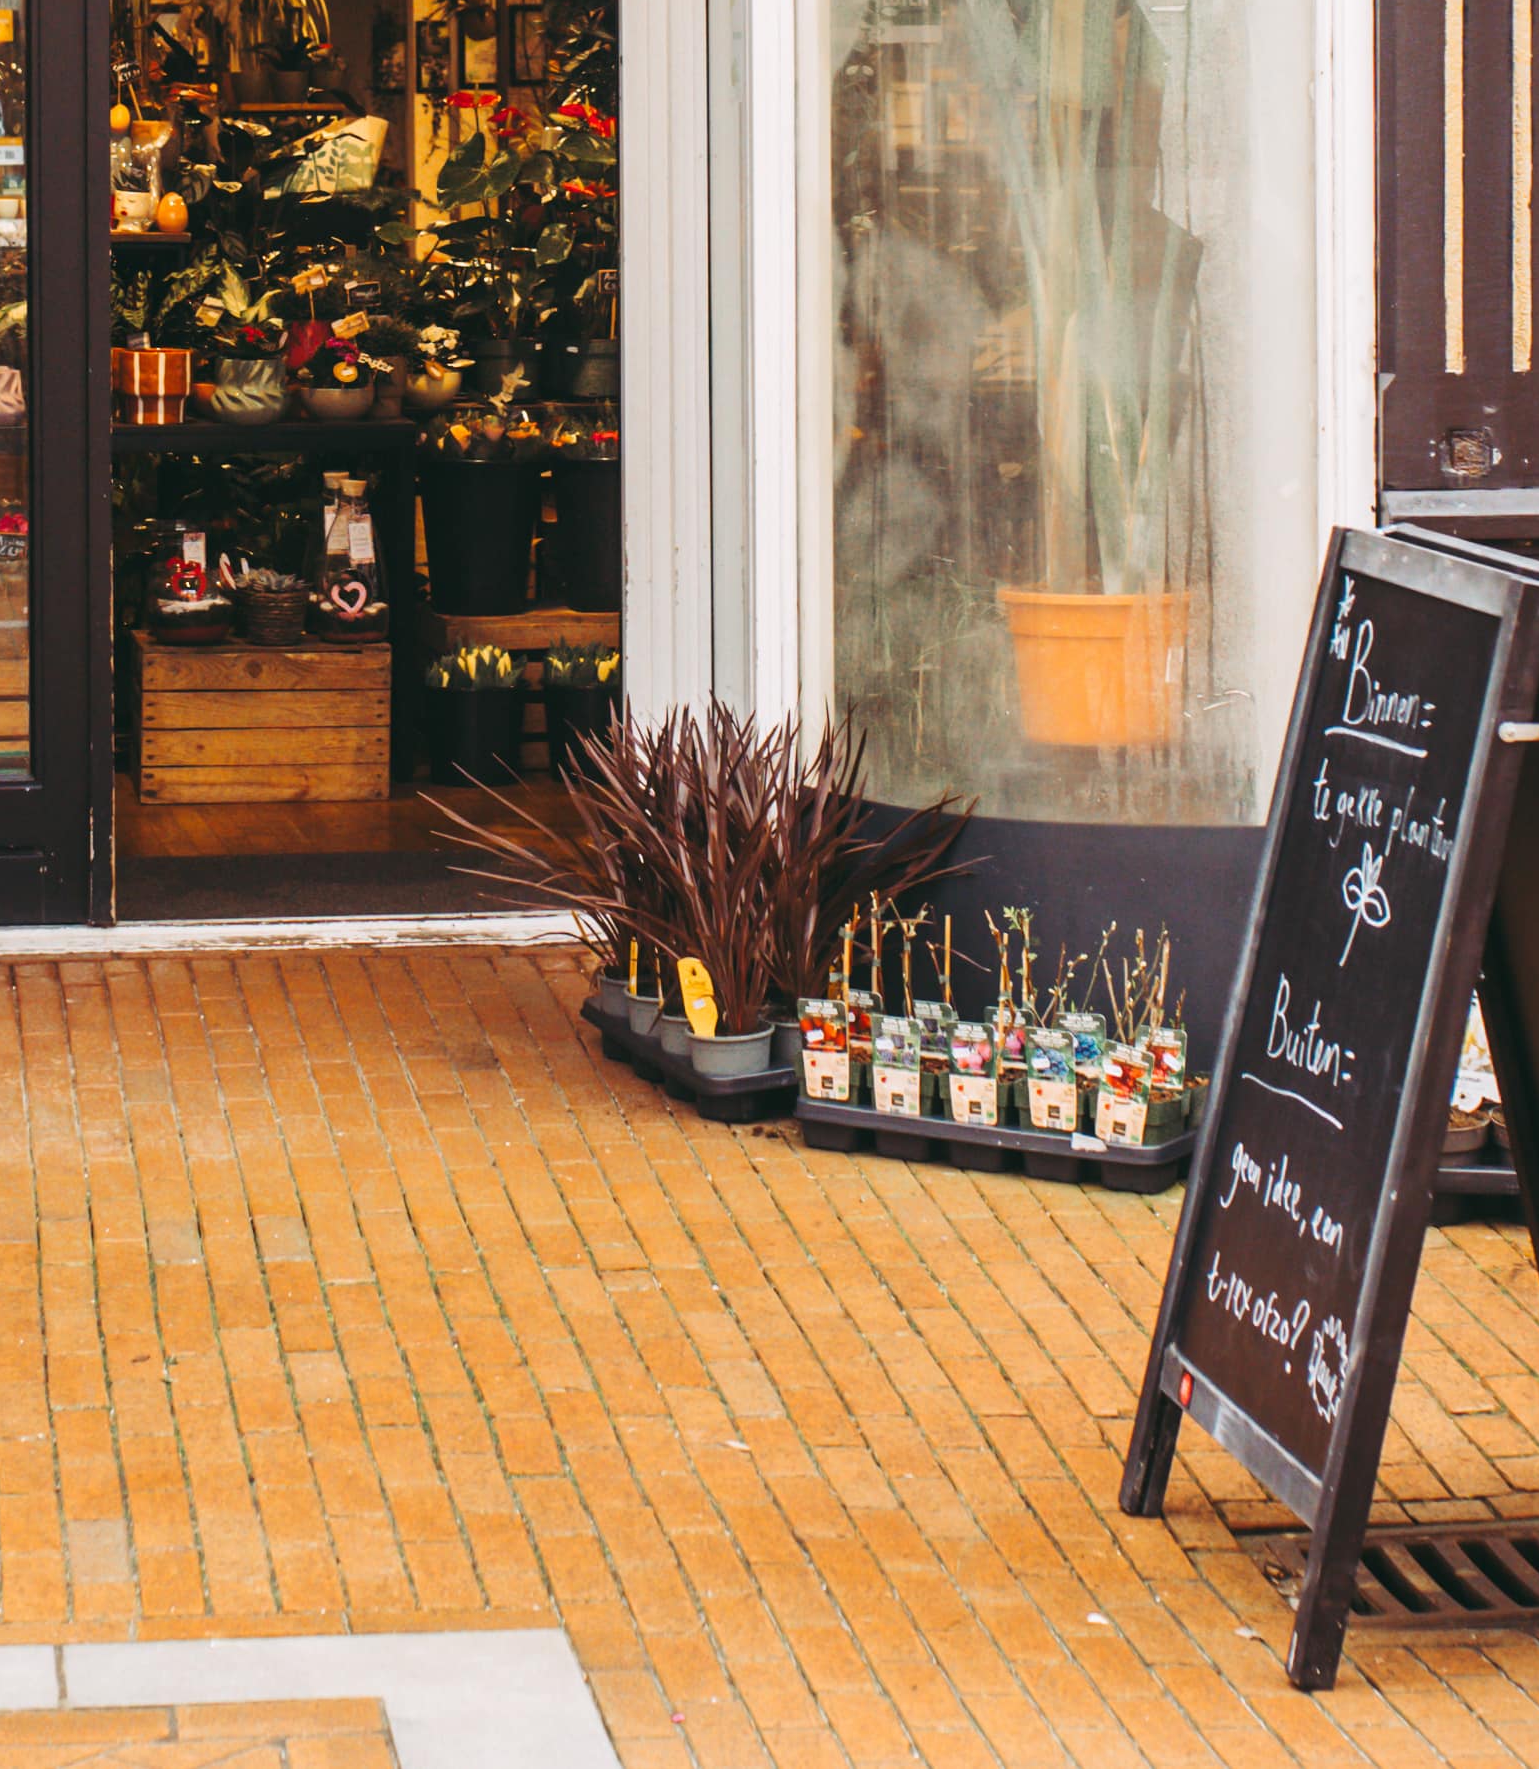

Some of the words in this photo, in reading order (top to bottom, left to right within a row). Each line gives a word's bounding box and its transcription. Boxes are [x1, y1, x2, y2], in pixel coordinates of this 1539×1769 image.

[1328, 784, 1383, 848] gekke
[1384, 784, 1455, 861] planten
[1311, 1206, 1344, 1258] een
